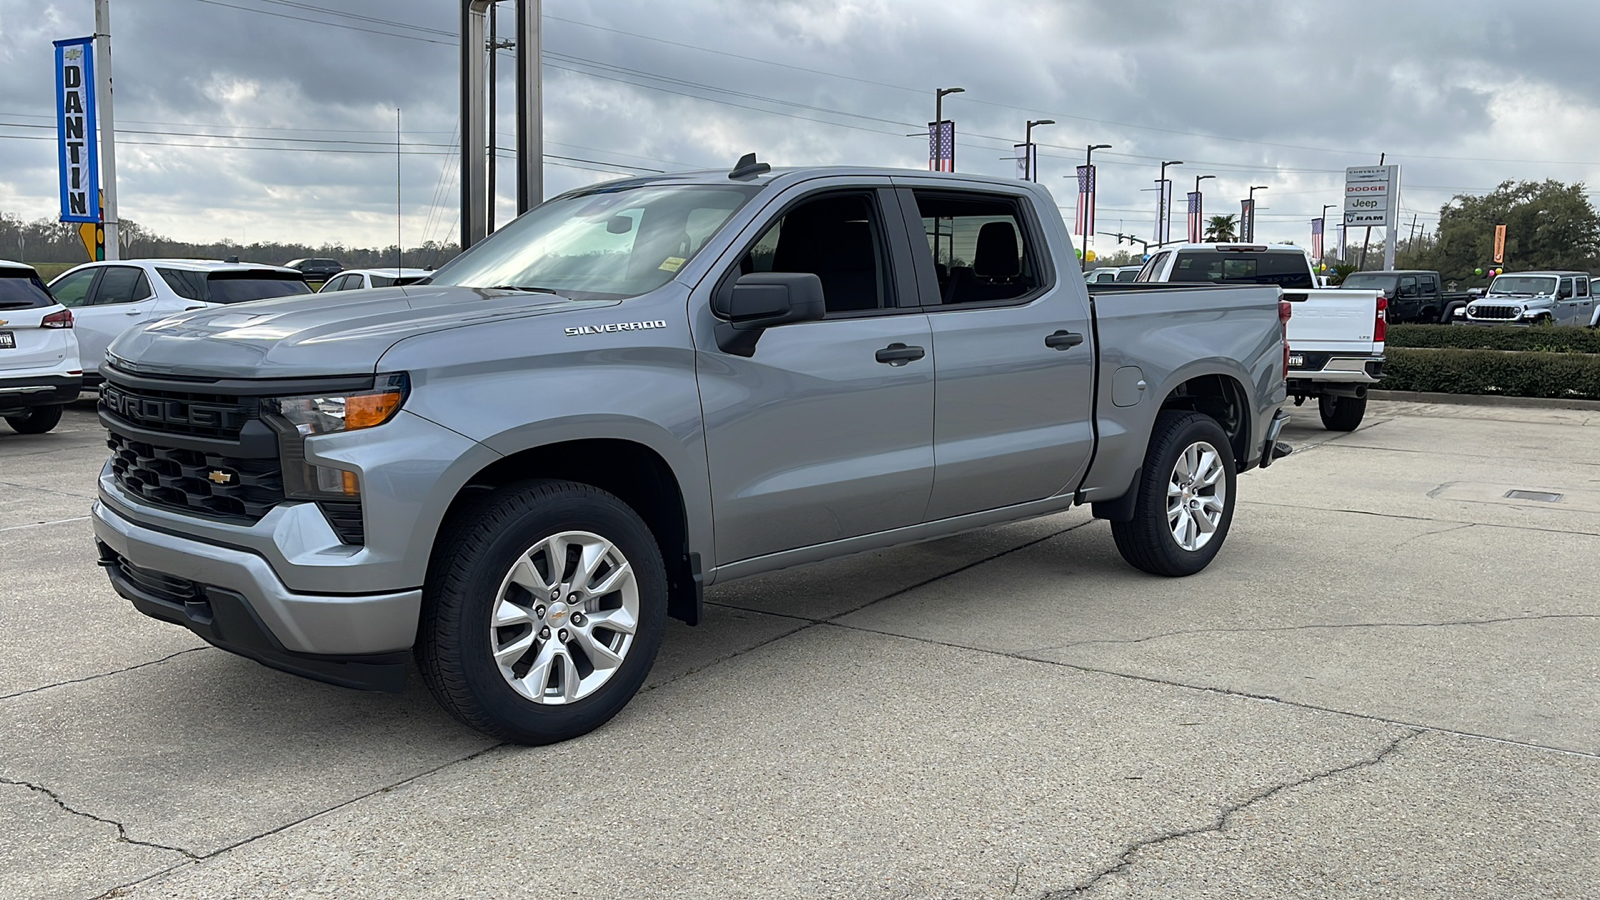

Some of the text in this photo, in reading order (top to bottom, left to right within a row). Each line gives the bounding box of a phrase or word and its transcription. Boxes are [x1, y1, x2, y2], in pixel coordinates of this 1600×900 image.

[65, 65, 87, 214] DANTIN
[1352, 199, 1378, 208] Jeep
[564, 320, 667, 336] SILVERADO
